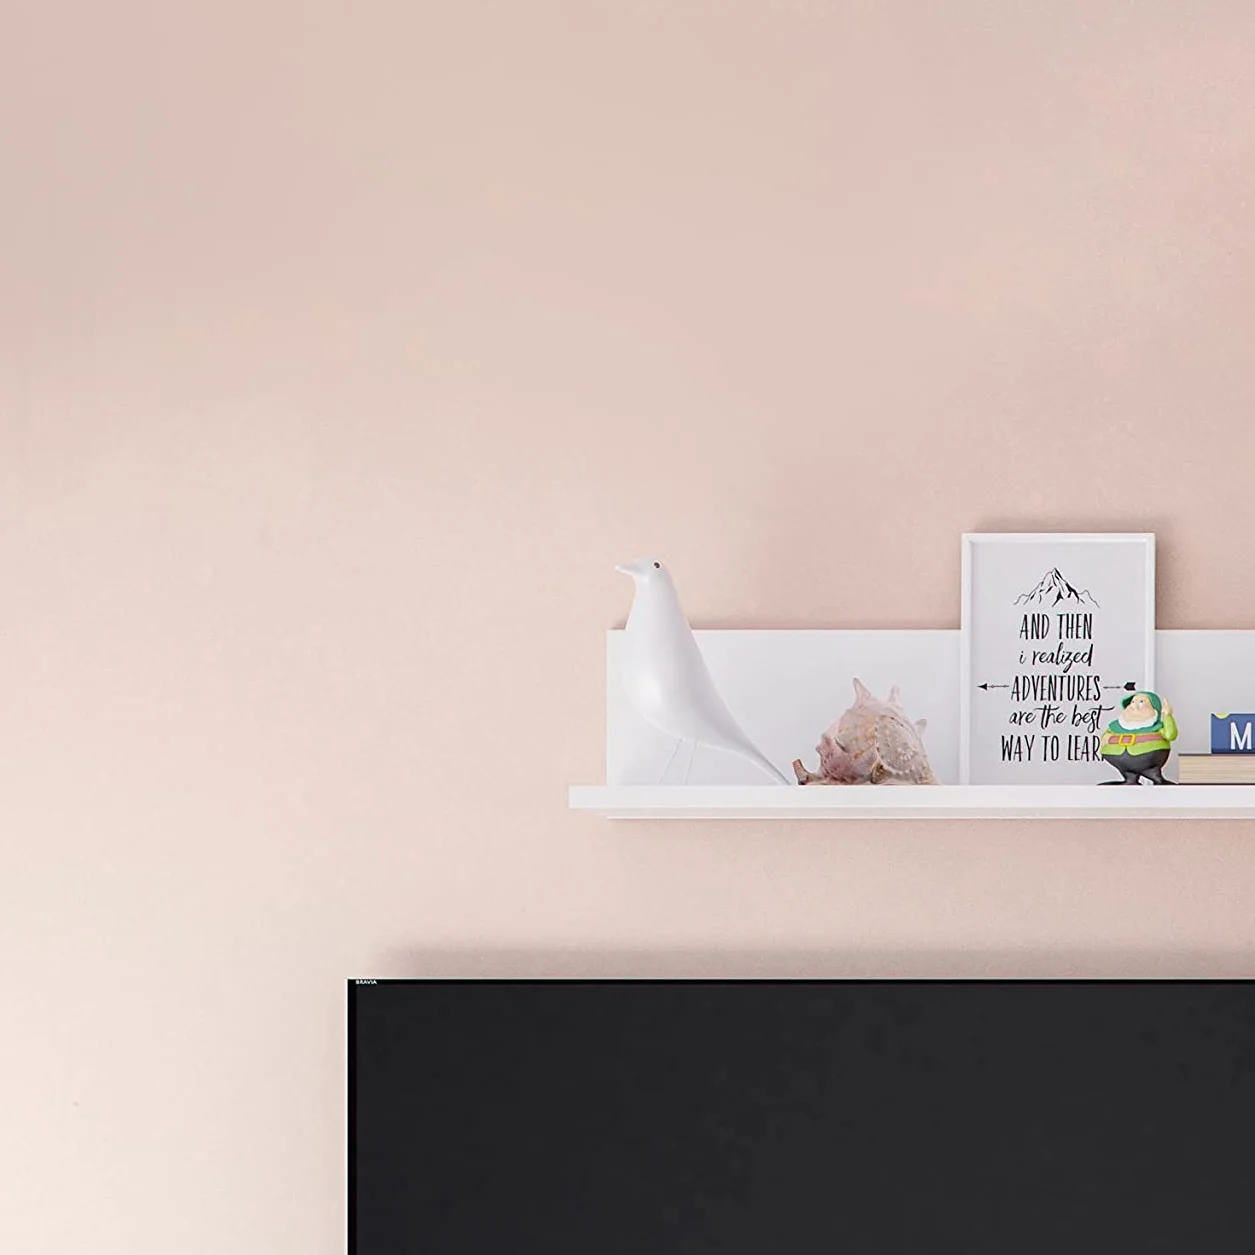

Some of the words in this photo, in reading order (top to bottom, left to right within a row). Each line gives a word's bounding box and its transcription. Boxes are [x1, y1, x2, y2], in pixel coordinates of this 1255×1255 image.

[1019, 613, 1049, 640] AND
[1057, 613, 1093, 640] THEN
[1019, 650, 1027, 665] i
[1032, 642, 1094, 673] realized
[1011, 675, 1101, 702] ADVENTURES
[1009, 711, 1036, 727] are
[1036, 704, 1067, 728] the
[1071, 704, 1116, 733] best
[1001, 734, 1035, 762] WAY
[1042, 734, 1060, 762] TO
[1067, 734, 1105, 762] LEAR
